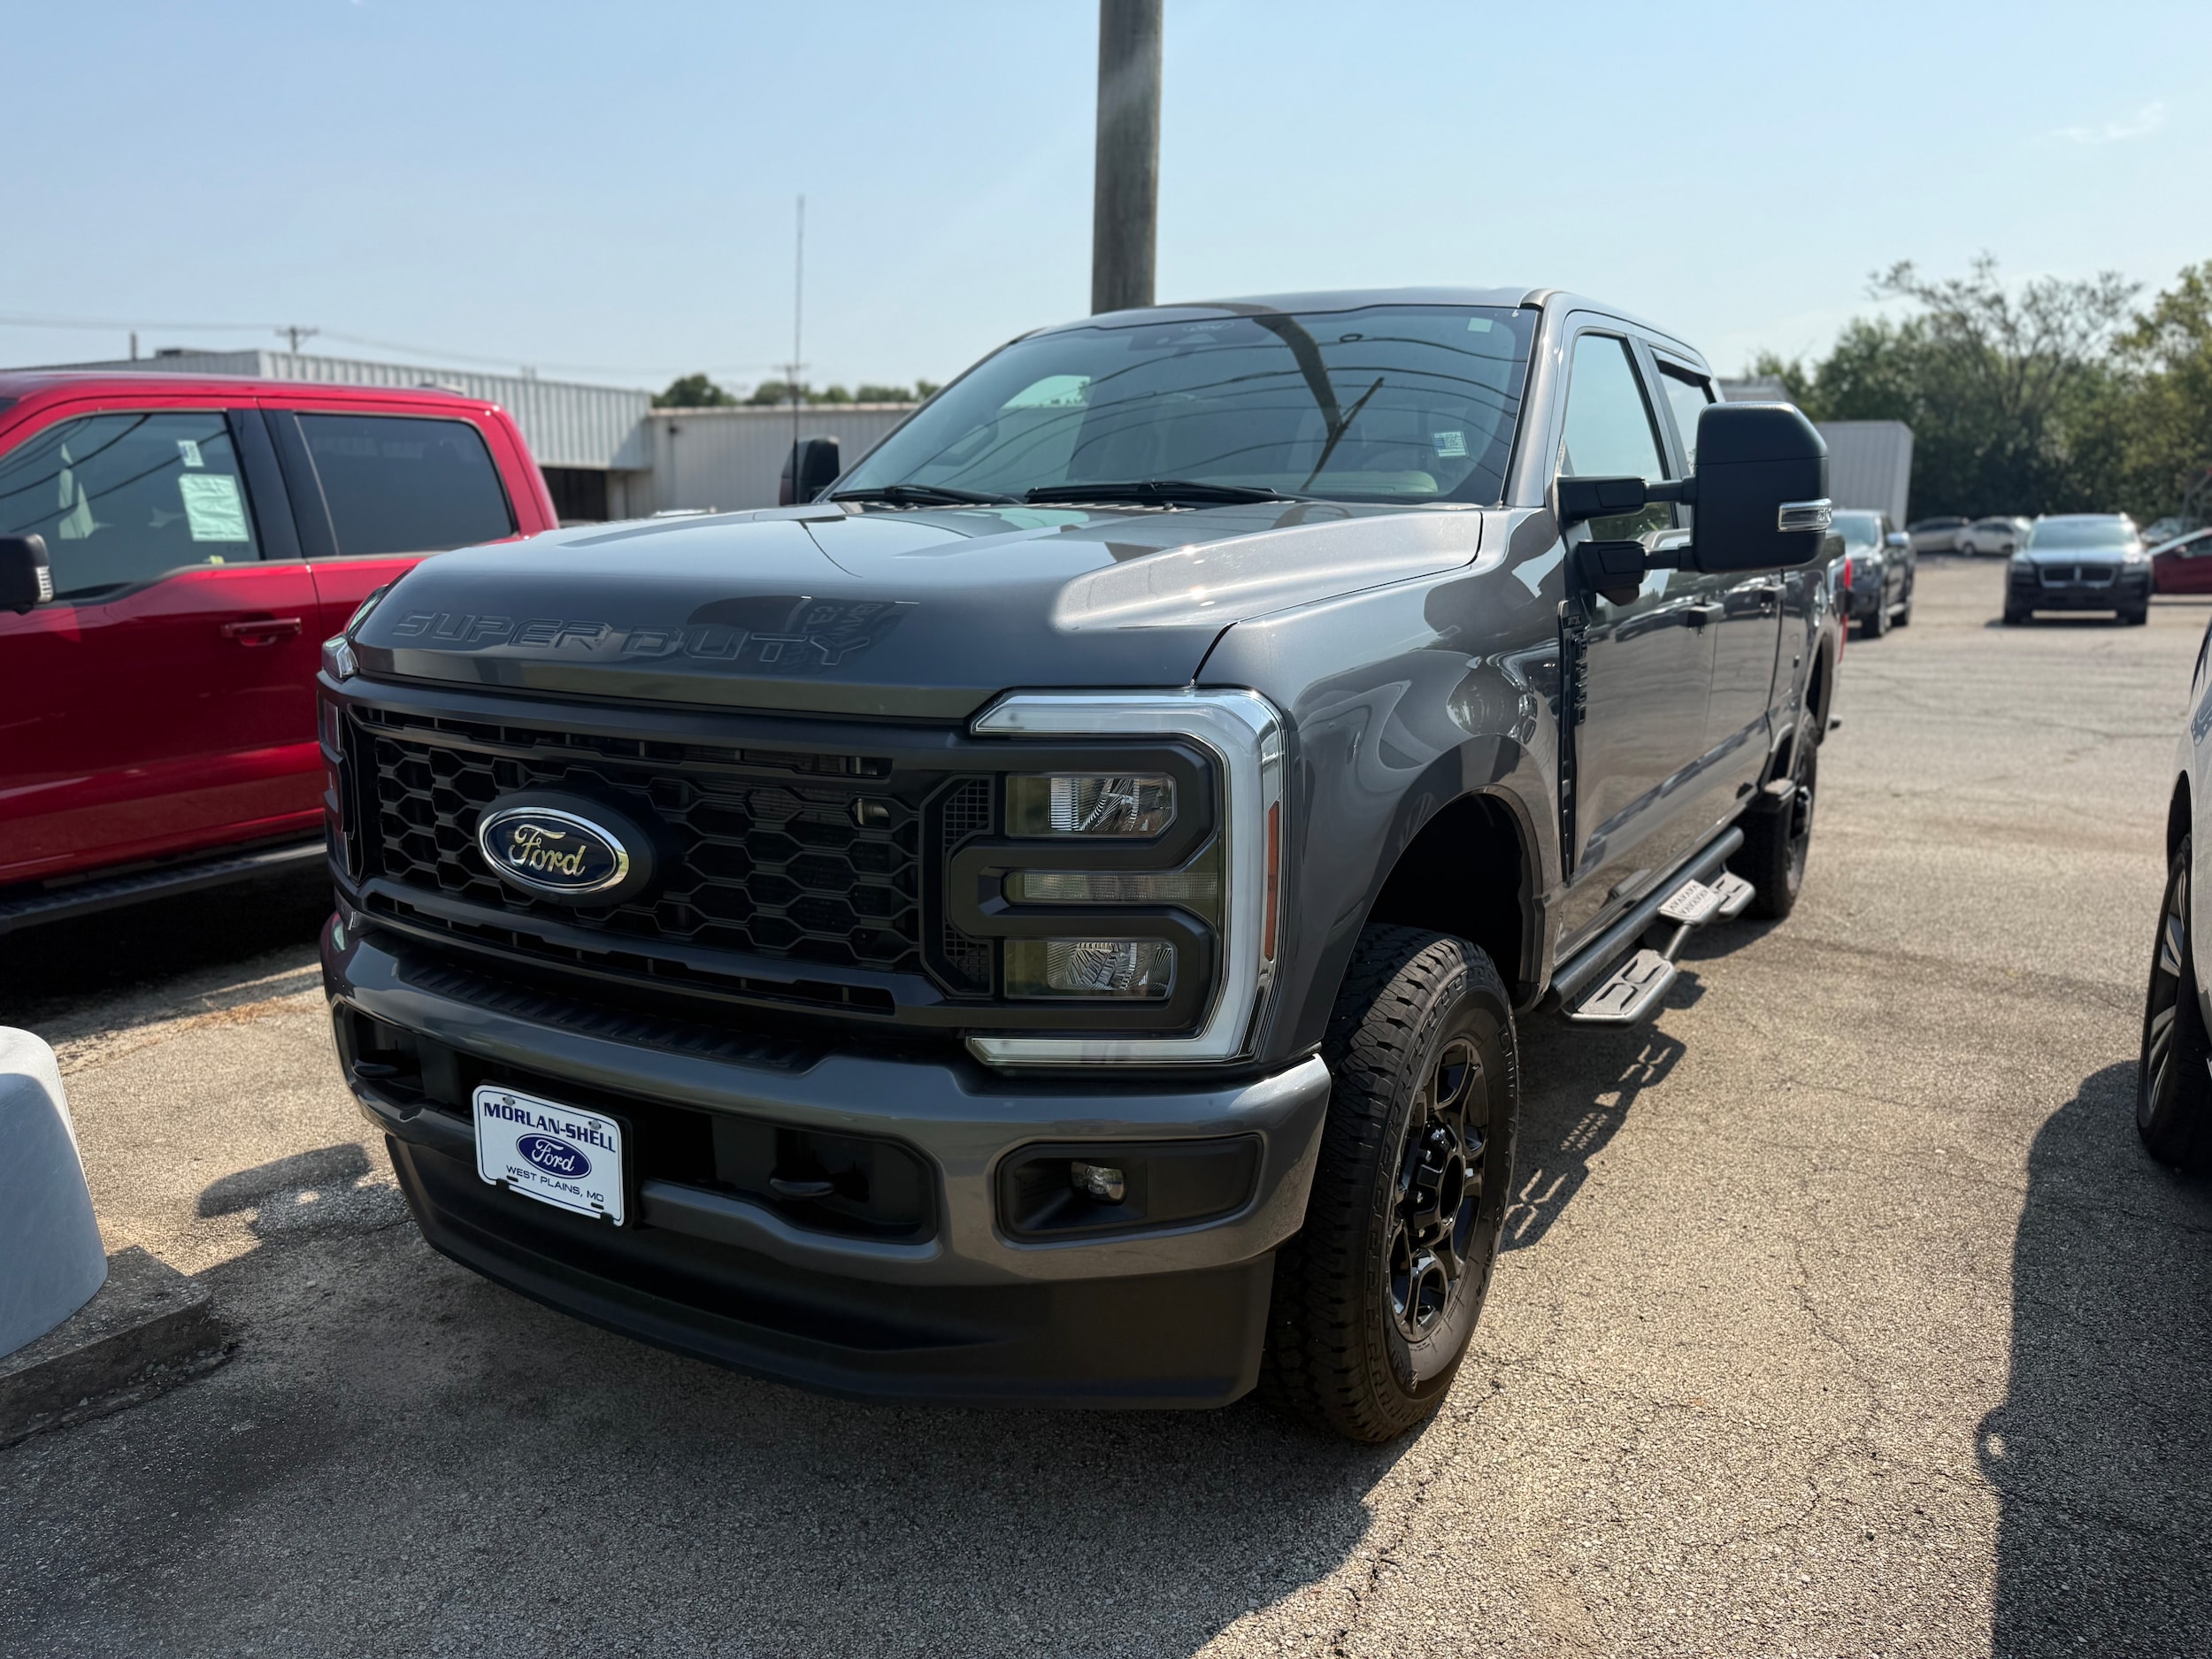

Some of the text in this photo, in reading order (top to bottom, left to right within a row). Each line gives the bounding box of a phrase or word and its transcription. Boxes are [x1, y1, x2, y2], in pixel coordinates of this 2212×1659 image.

[392, 610, 871, 665] SUPER DUTY
[508, 823, 587, 878] Ford
[484, 1102, 616, 1154] MORLAN-SHELL
[531, 1139, 575, 1172] Ford
[506, 1164, 604, 1202] WEST PLAINS, MO
